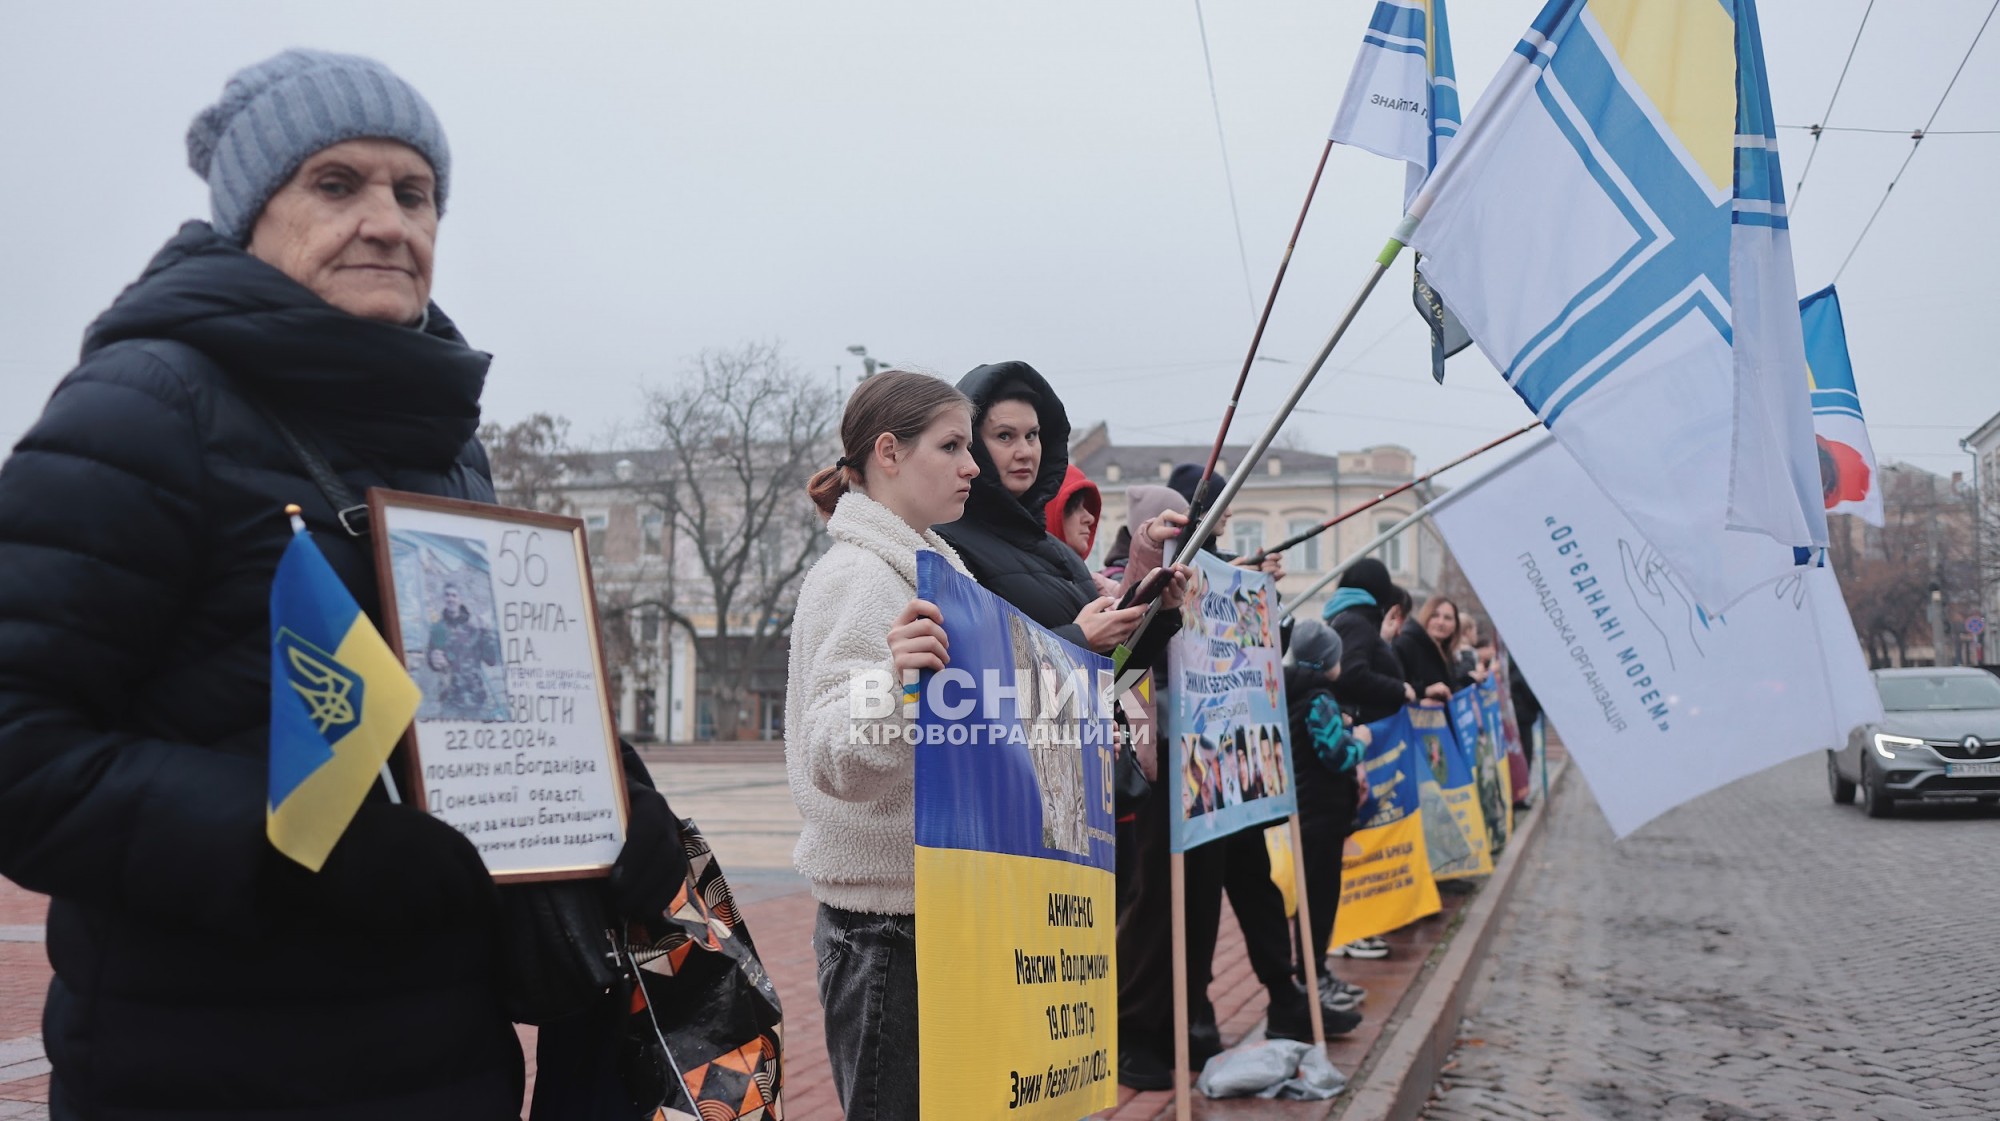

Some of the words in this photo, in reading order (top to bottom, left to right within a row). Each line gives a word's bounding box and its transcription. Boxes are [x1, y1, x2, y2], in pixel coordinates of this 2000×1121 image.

[499, 530, 548, 587] 56
[1517, 551, 1576, 647] ГРОМАДСЬКА
[1570, 646, 1628, 734] ОРГАНІЗАЦІЯ
[1616, 647, 1669, 733] МОРЕМ»
[426, 761, 490, 780] поблизу
[515, 753, 596, 776] Богданівка
[430, 786, 519, 815] Донецької
[485, 820, 498, 831] за
[501, 815, 535, 828] нашу
[537, 806, 614, 825] Батьківщину
[1014, 948, 1057, 985] Максим
[1009, 1070, 1043, 1109] Зник
